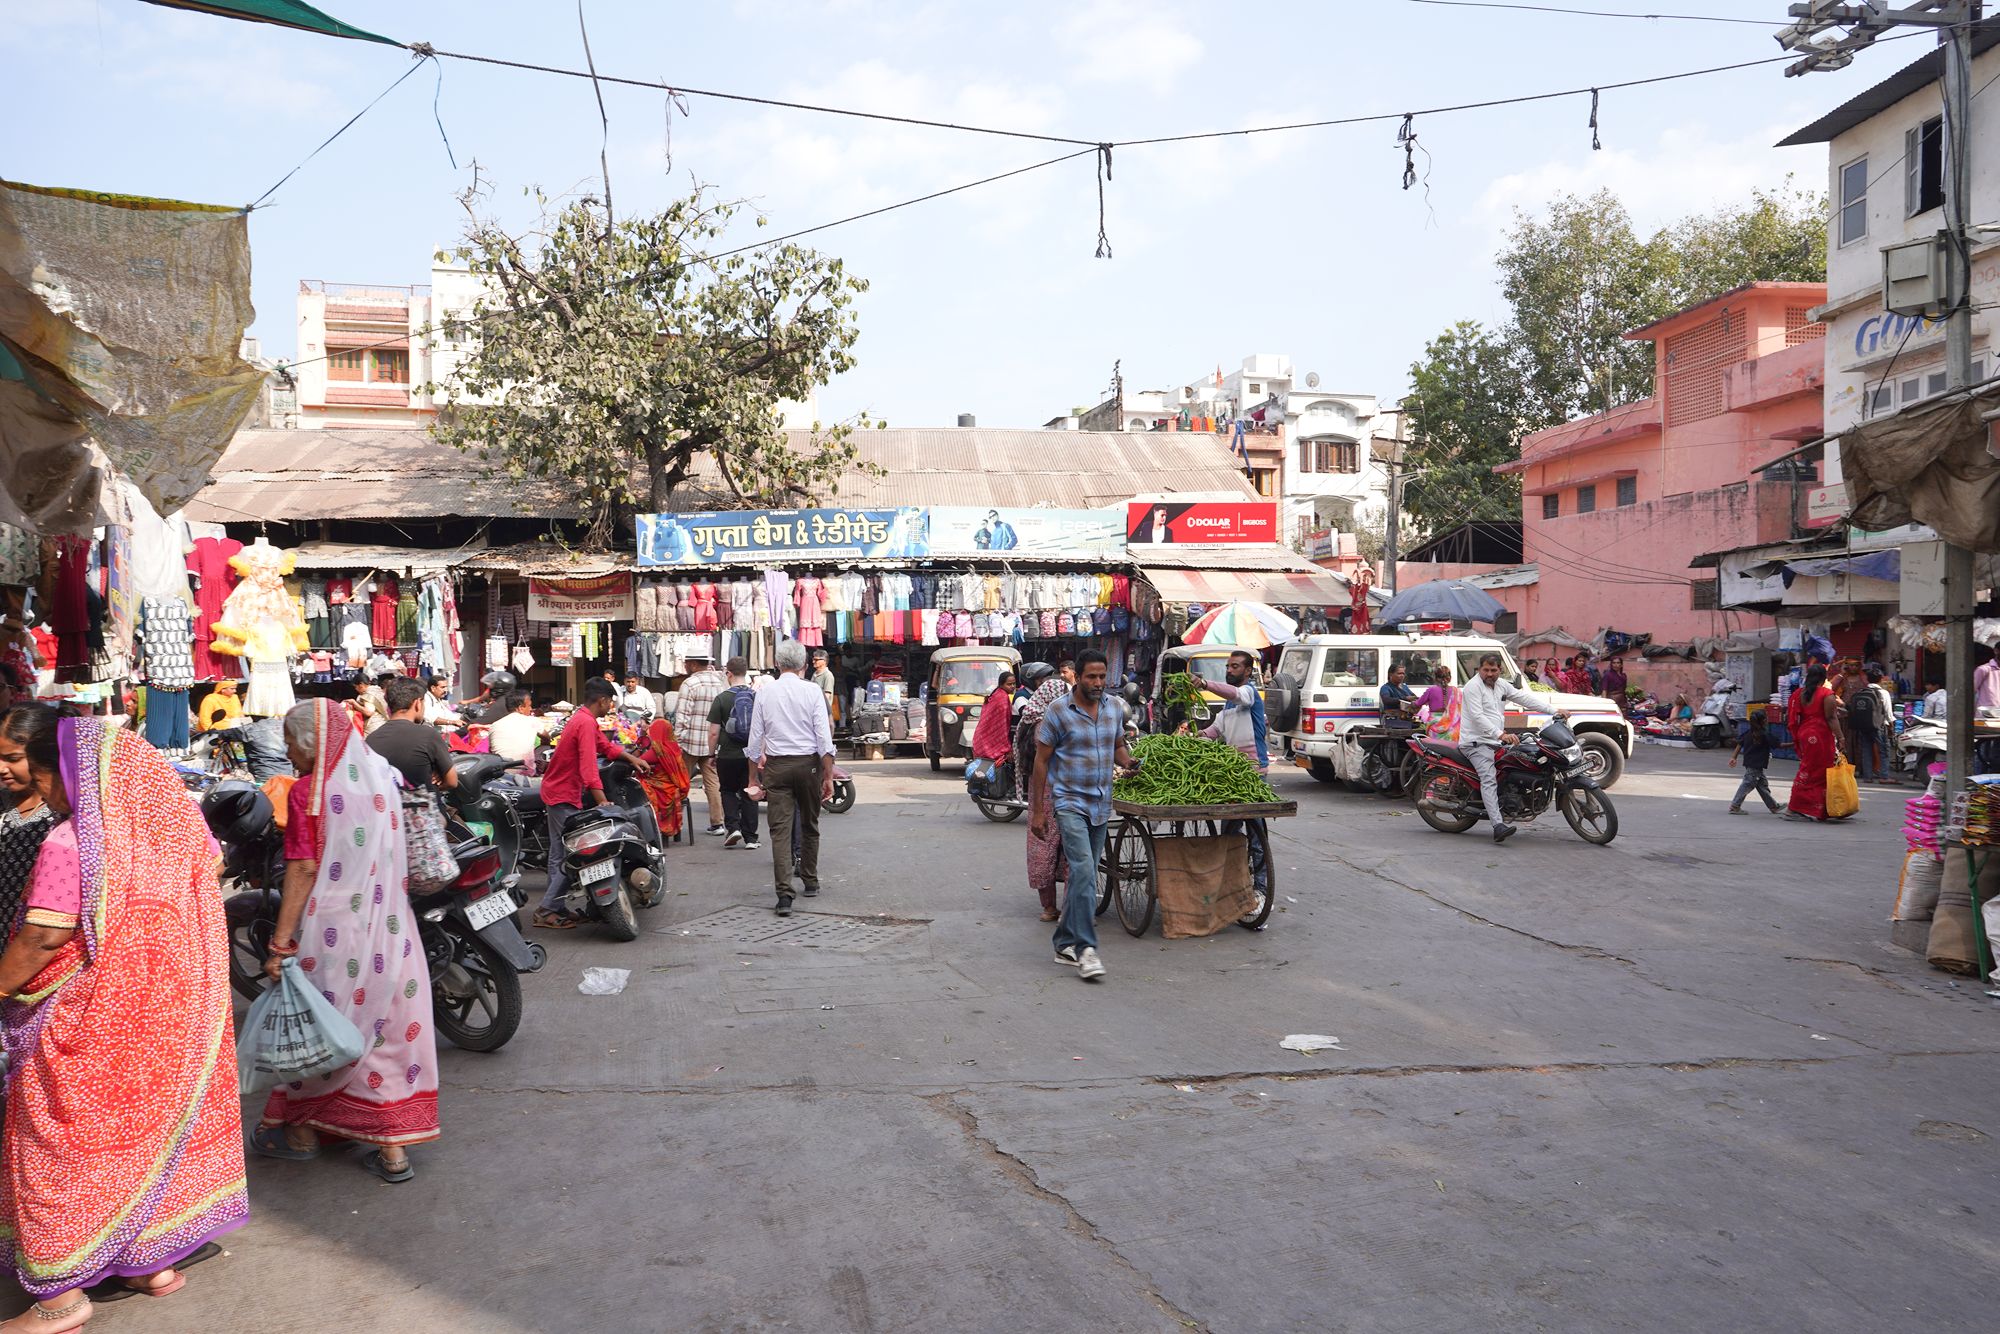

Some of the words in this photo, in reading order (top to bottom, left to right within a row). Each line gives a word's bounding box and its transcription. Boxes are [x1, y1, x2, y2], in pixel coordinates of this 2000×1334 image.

[1195, 518, 1231, 527] DOLLAR
[693, 525, 749, 557] गुप्ता
[752, 515, 792, 546] बैग
[796, 519, 810, 545] &
[812, 512, 889, 545] रेडीमेड
[567, 579, 598, 589] मसाला
[537, 599, 549, 609] श्री
[550, 600, 572, 611] श्याम
[482, 903, 512, 924] S1381
